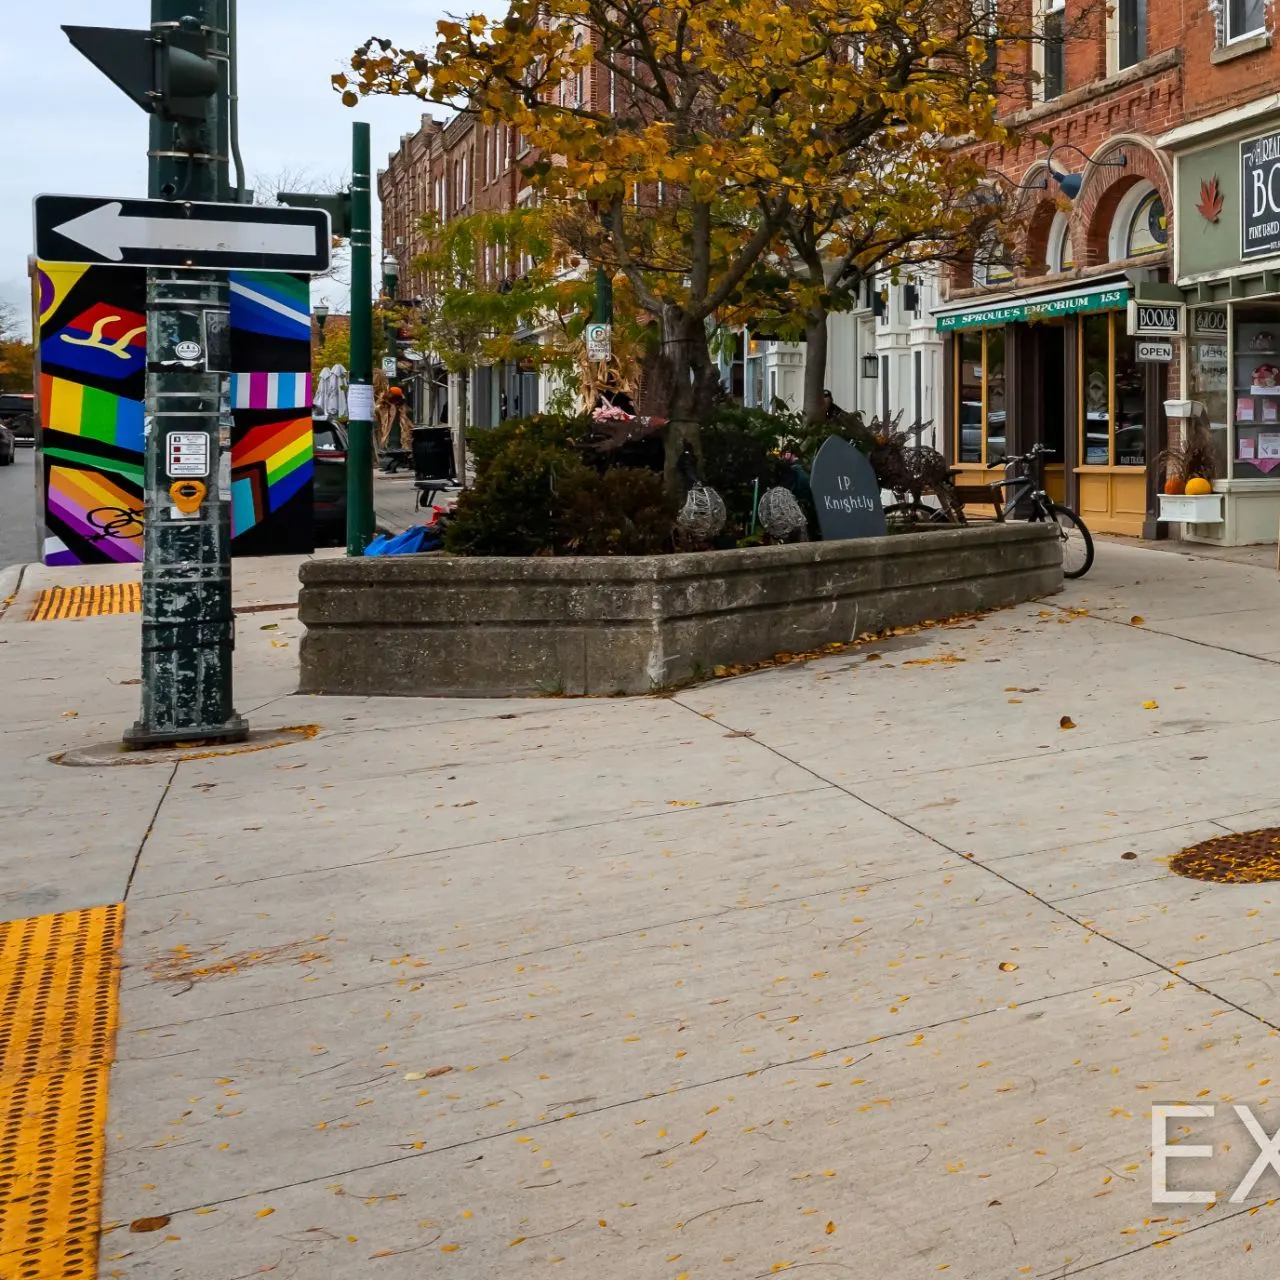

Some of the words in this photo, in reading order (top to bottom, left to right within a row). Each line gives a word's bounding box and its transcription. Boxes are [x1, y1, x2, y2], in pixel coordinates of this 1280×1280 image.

[1262, 221, 1280, 237] USED
[941, 317, 956, 326] 153
[961, 306, 1021, 324] SPROULE'S
[1024, 296, 1089, 316] EMPORIUM
[1100, 291, 1121, 303] 153
[1139, 308, 1176, 326] BOOKS
[1140, 346, 1171, 357] OPEN
[824, 495, 875, 513] Knightly
